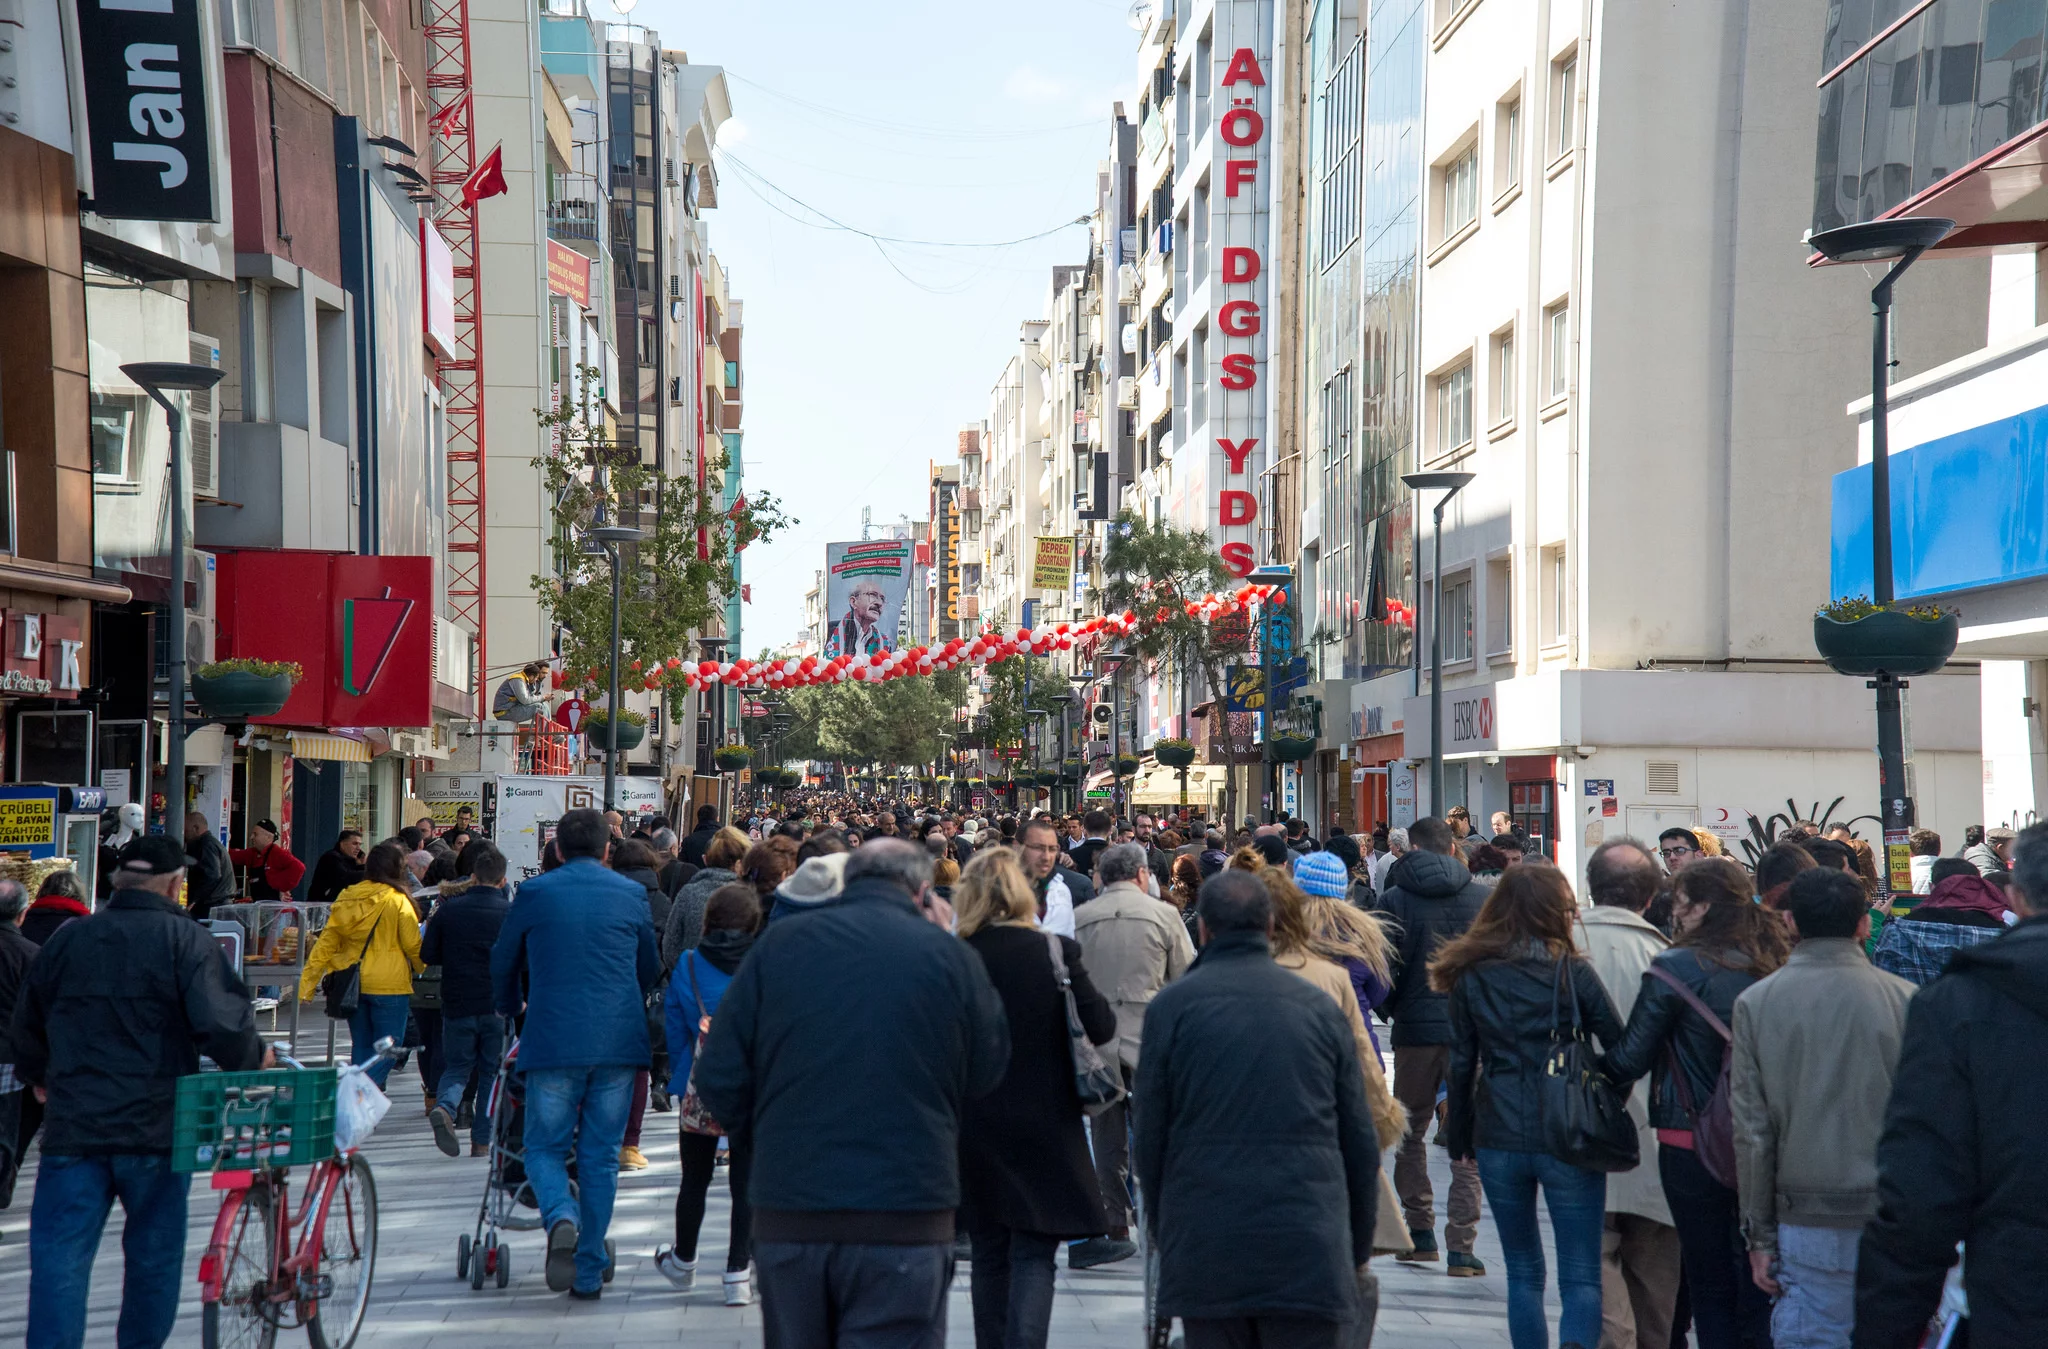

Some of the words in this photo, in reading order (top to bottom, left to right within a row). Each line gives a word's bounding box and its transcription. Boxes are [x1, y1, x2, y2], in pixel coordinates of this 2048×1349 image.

[112, 42, 189, 189] Jan
[1221, 47, 1266, 198] AÖF
[1218, 246, 1261, 391] DGS
[1216, 438, 1260, 579] YDS
[1041, 542, 1069, 555] DEPREM
[1454, 699, 1479, 741] HSBC
[450, 790, 471, 798] İNŞAAT
[514, 788, 544, 797] Garanti
[630, 791, 656, 800] Garanti
[16, 816, 51, 825] BAYAN
